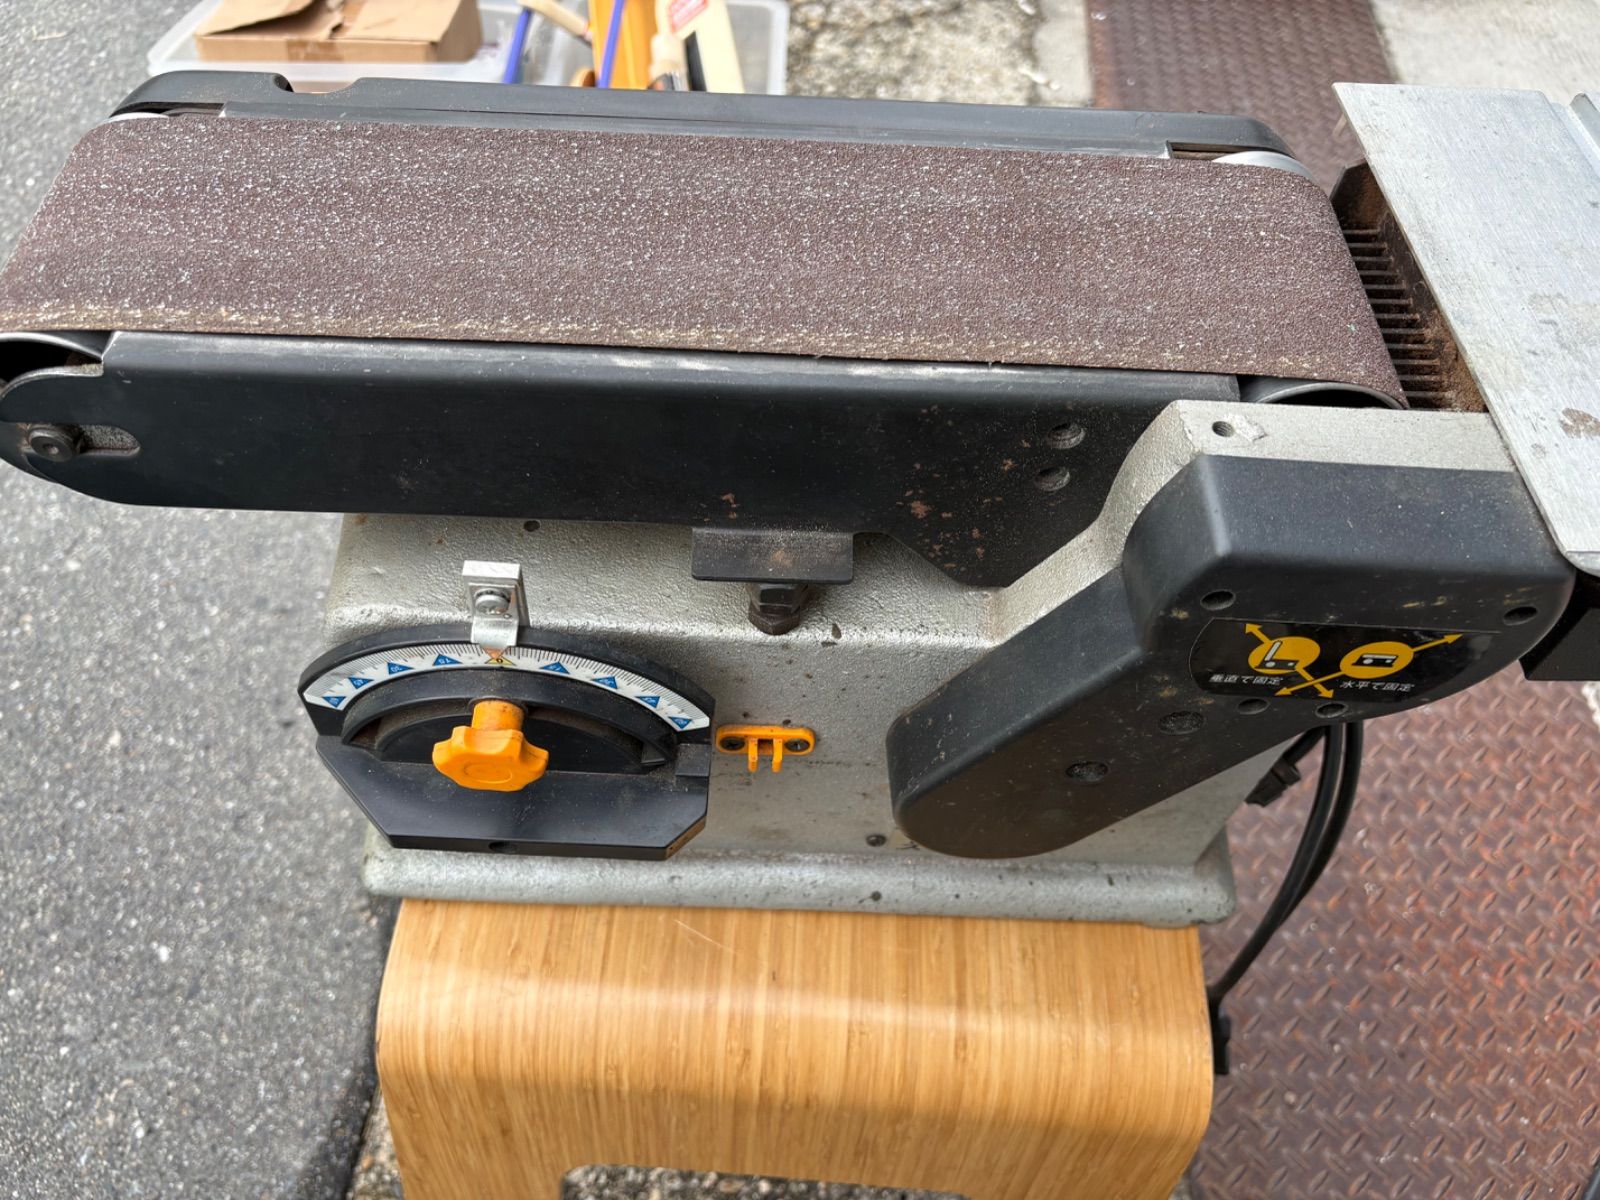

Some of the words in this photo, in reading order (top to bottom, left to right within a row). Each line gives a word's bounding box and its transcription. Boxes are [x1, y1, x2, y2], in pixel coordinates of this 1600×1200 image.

[1209, 674, 1283, 686] 垂直で固定
[1340, 680, 1415, 691] 水平で固定
